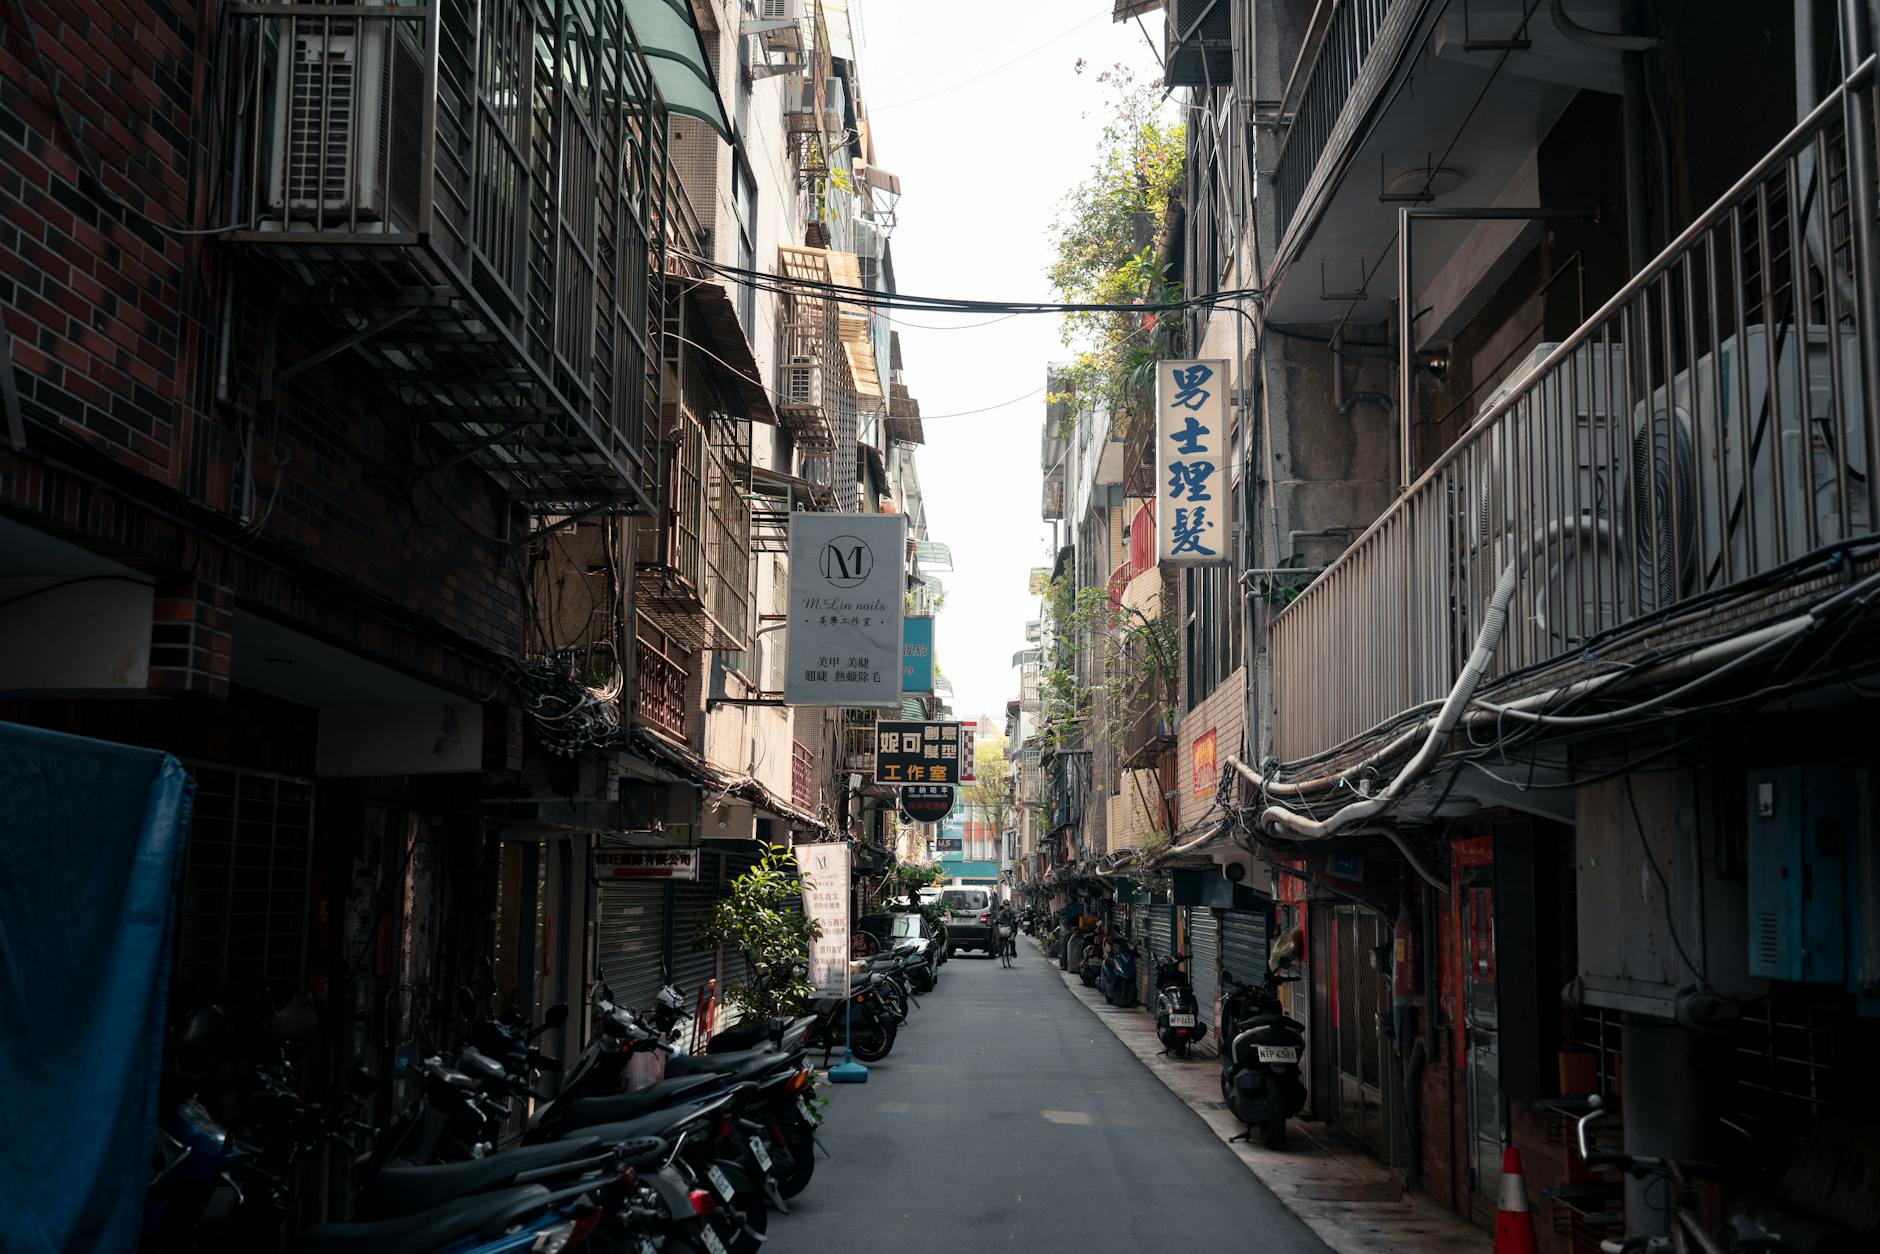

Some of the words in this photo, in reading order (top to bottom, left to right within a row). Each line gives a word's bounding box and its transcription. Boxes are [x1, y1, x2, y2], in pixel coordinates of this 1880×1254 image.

[1168, 364, 1216, 556] 男士理髮
[824, 597, 853, 611] Lin
[855, 597, 887, 611] nails
[817, 656, 840, 668] 美甲
[879, 731, 922, 754] 妮可
[923, 743, 957, 759] 髮型
[884, 764, 948, 782] 工作室
